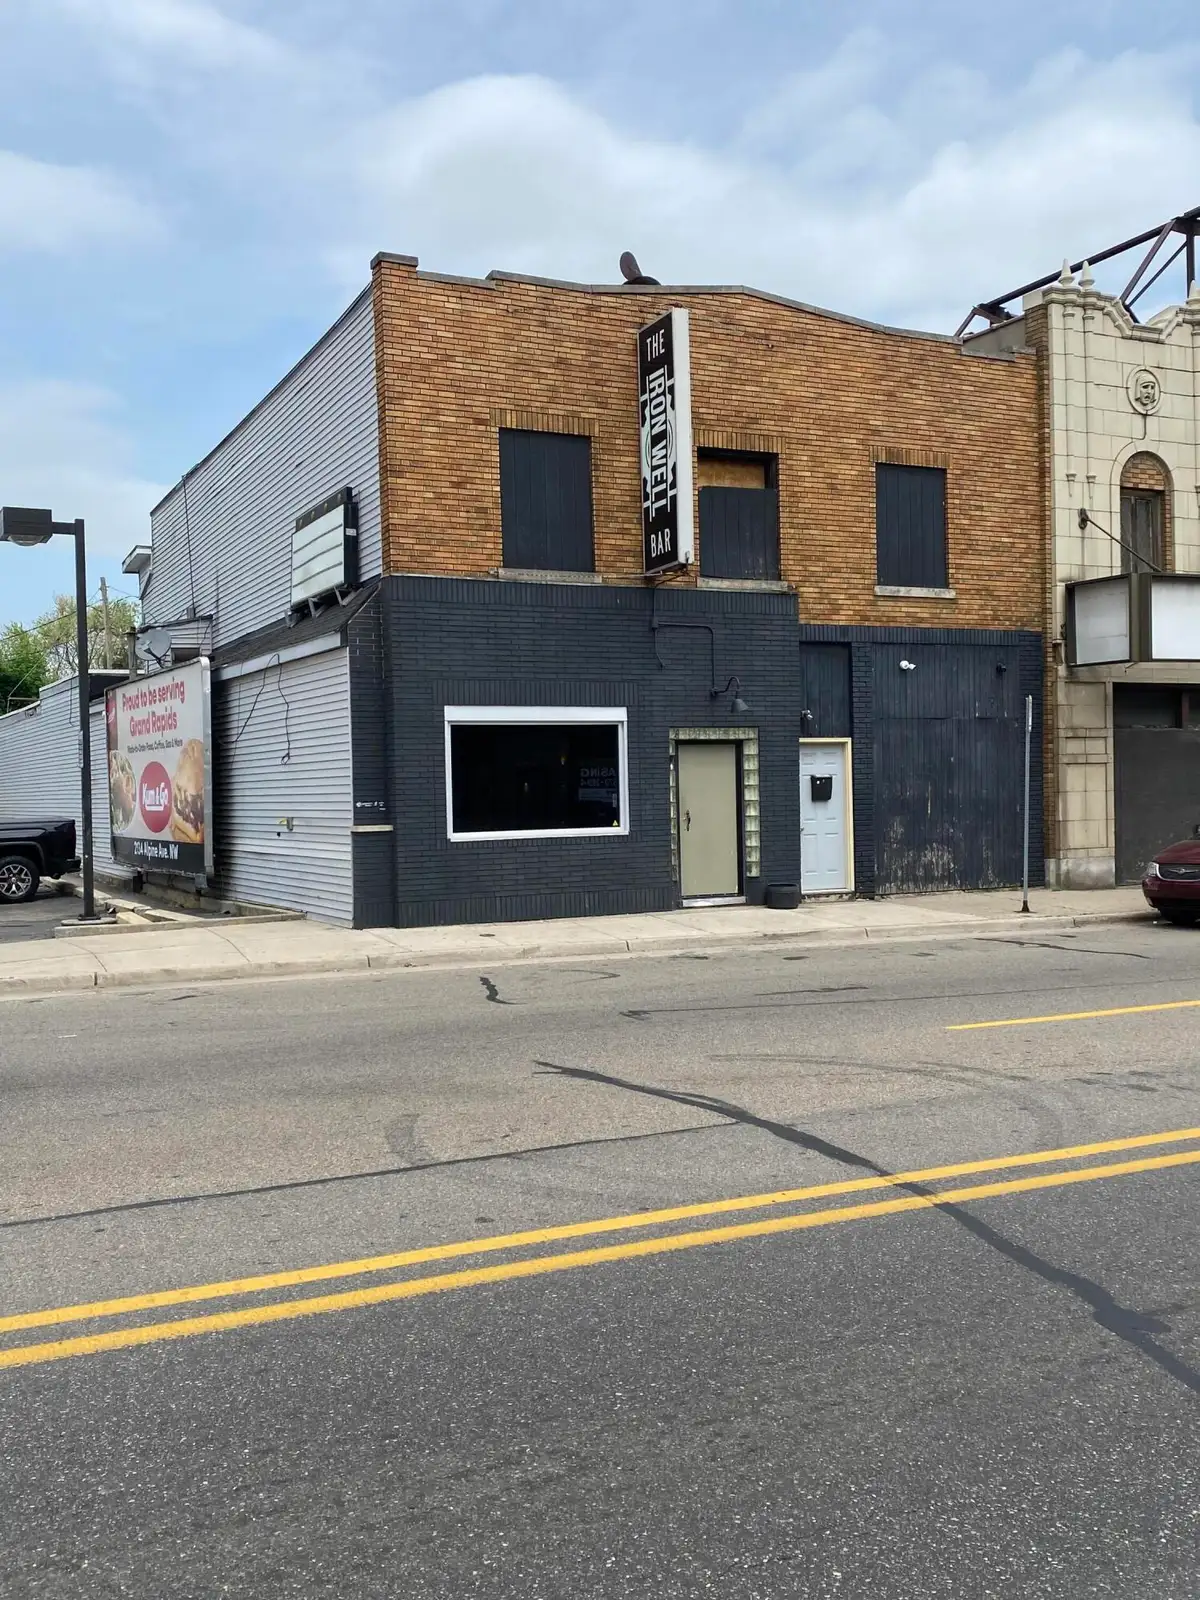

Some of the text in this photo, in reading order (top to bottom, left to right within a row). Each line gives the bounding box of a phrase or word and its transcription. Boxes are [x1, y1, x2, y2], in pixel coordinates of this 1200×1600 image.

[646, 328, 666, 362] THE
[649, 367, 667, 518] IRON WELL
[650, 528, 672, 558] BAR
[122, 676, 185, 712] Proud to be serving
[130, 706, 178, 738] Grand Rapids
[144, 841, 158, 860] Alpine
[169, 844, 178, 860] NW
